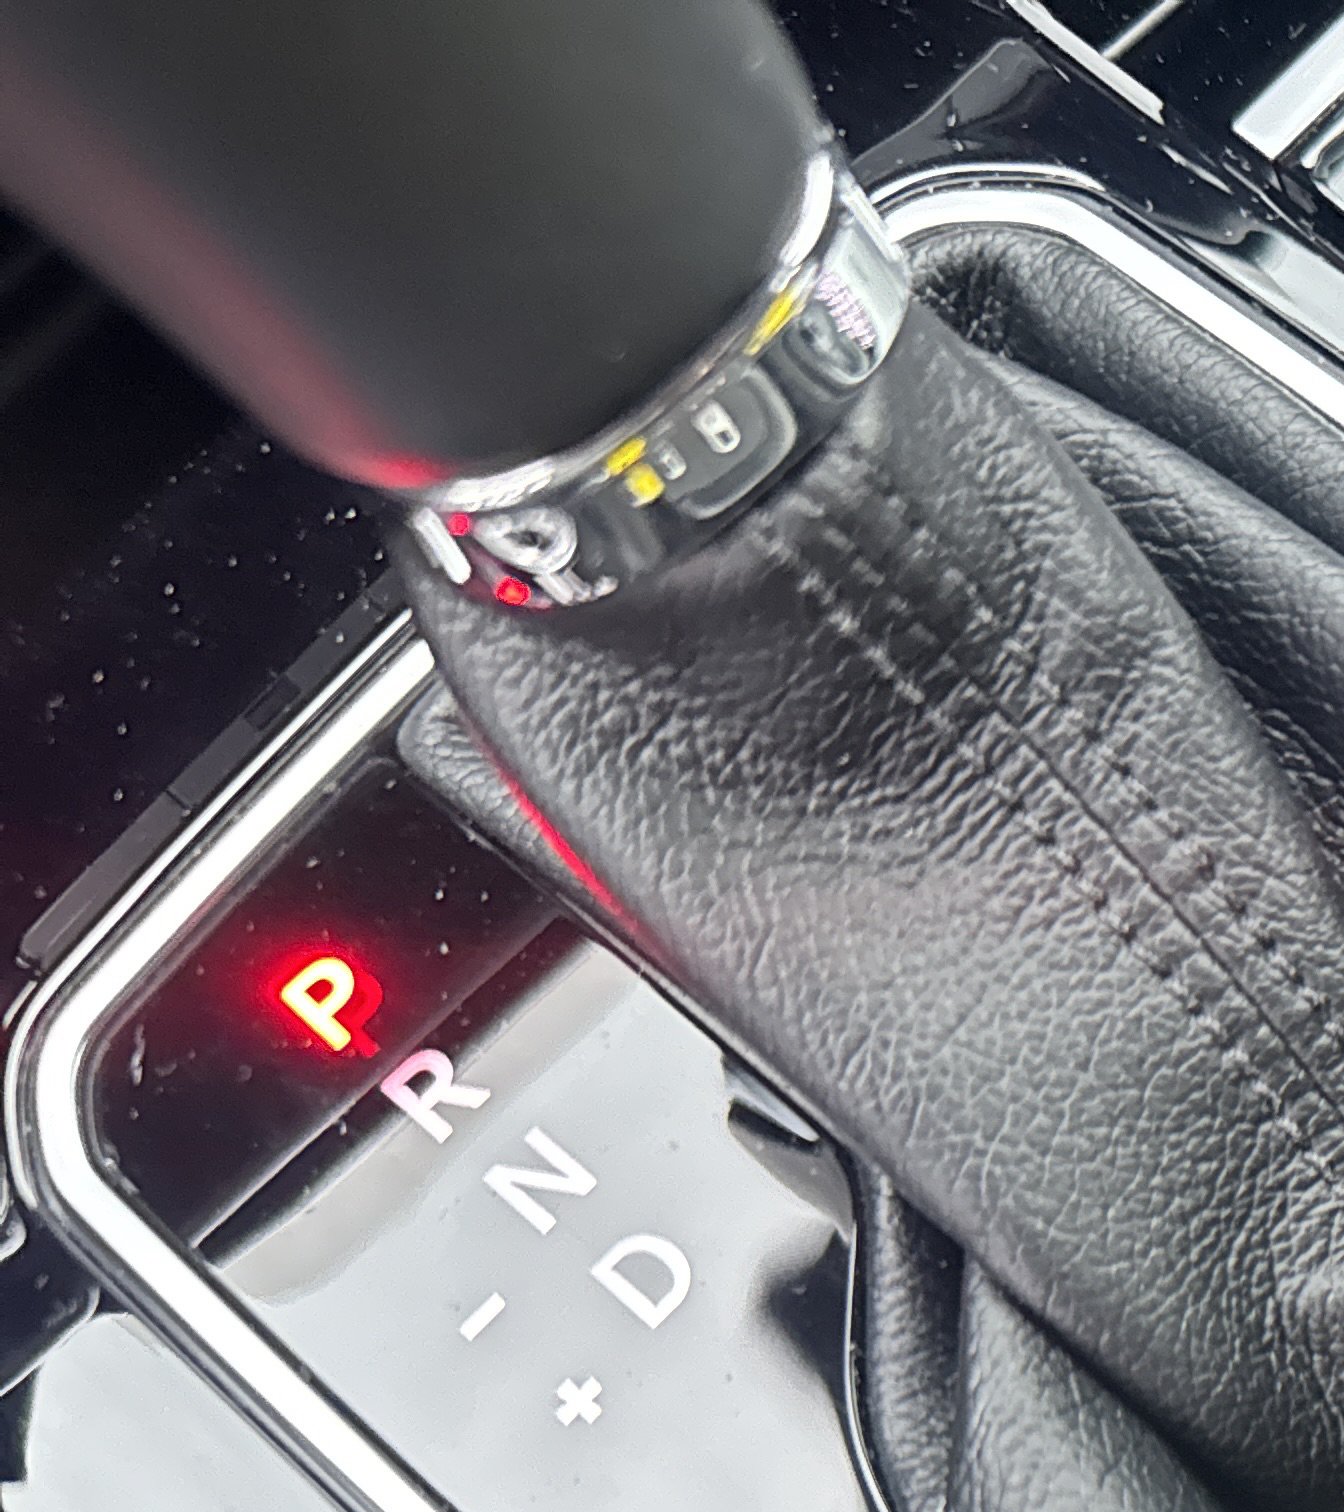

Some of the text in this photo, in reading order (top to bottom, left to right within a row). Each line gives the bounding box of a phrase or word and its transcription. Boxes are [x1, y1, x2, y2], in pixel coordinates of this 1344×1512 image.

[279, 955, 360, 1053] P
[380, 1049, 492, 1145] R
[483, 1127, 598, 1236] N
[590, 1233, 693, 1331] D
